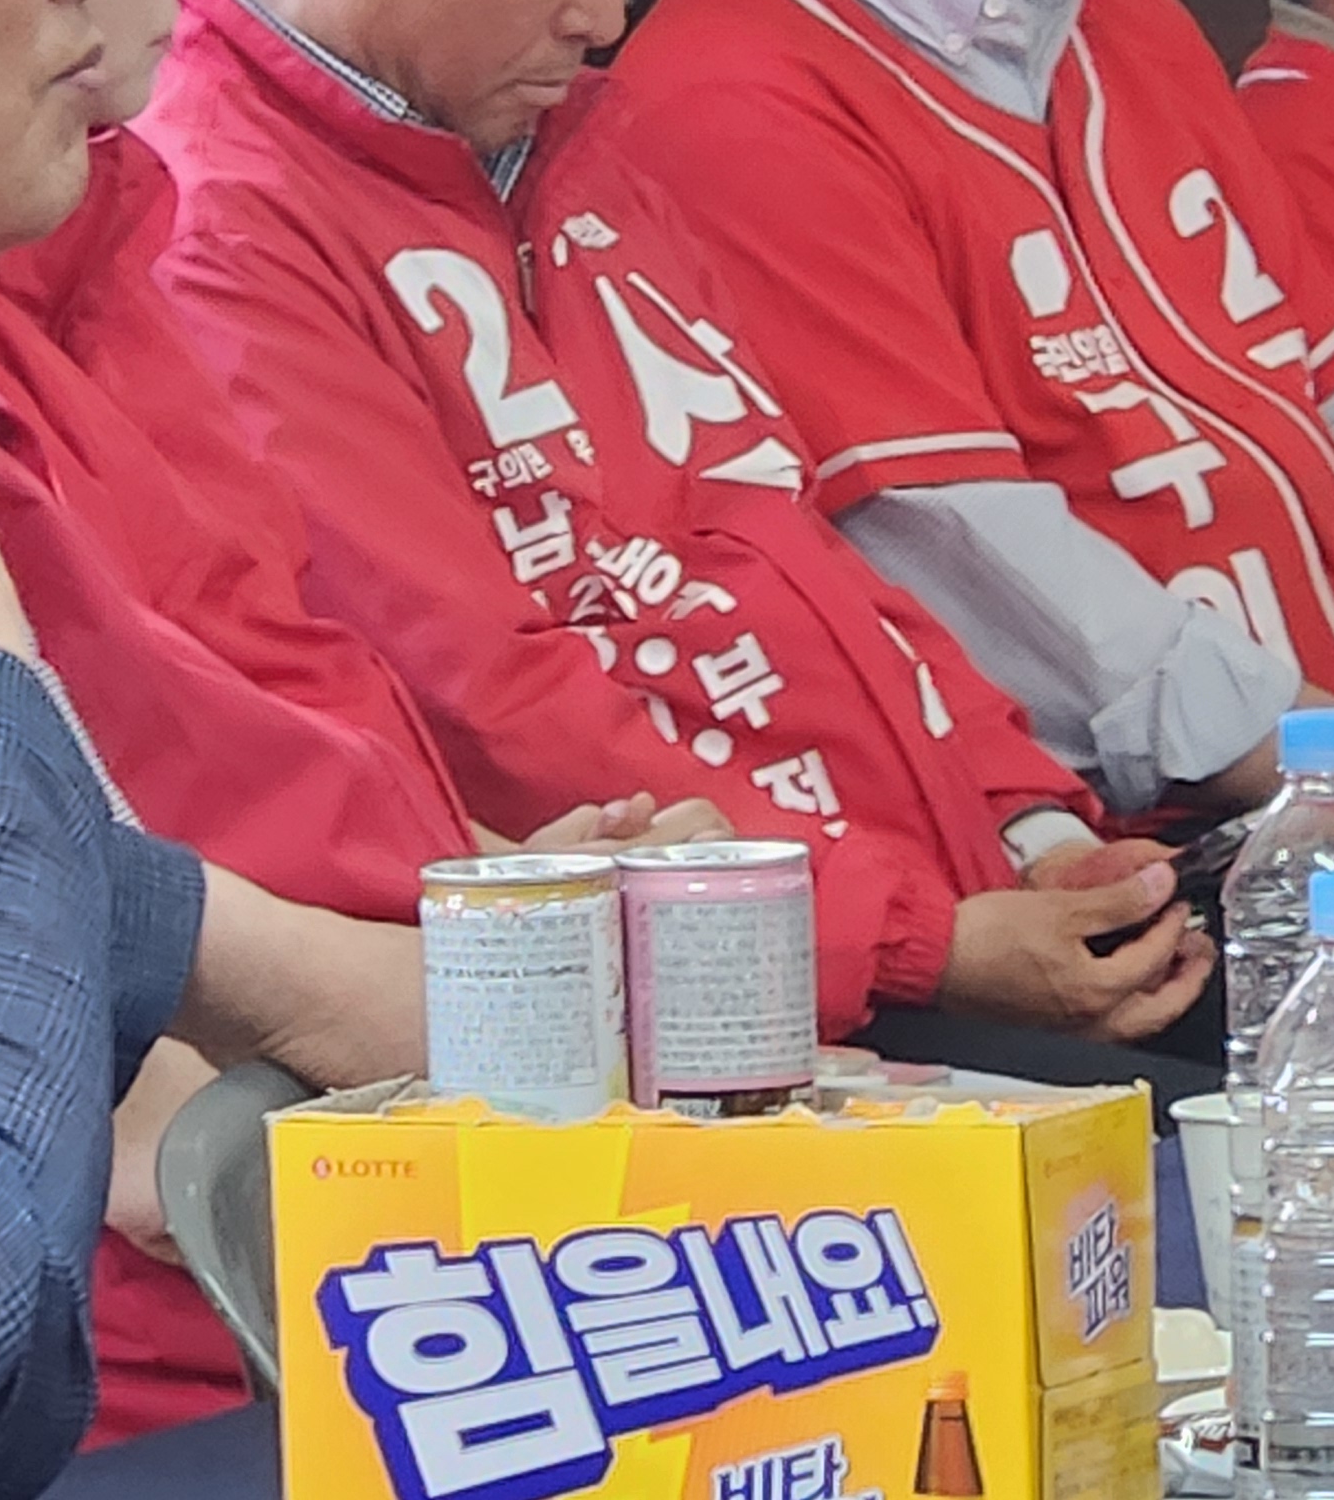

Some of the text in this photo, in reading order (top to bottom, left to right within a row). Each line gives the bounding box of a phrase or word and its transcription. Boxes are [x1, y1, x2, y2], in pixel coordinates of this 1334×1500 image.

[1170, 169, 1283, 323] 2
[384, 247, 579, 449] 2
[337, 1160, 417, 1178] LOTTE
